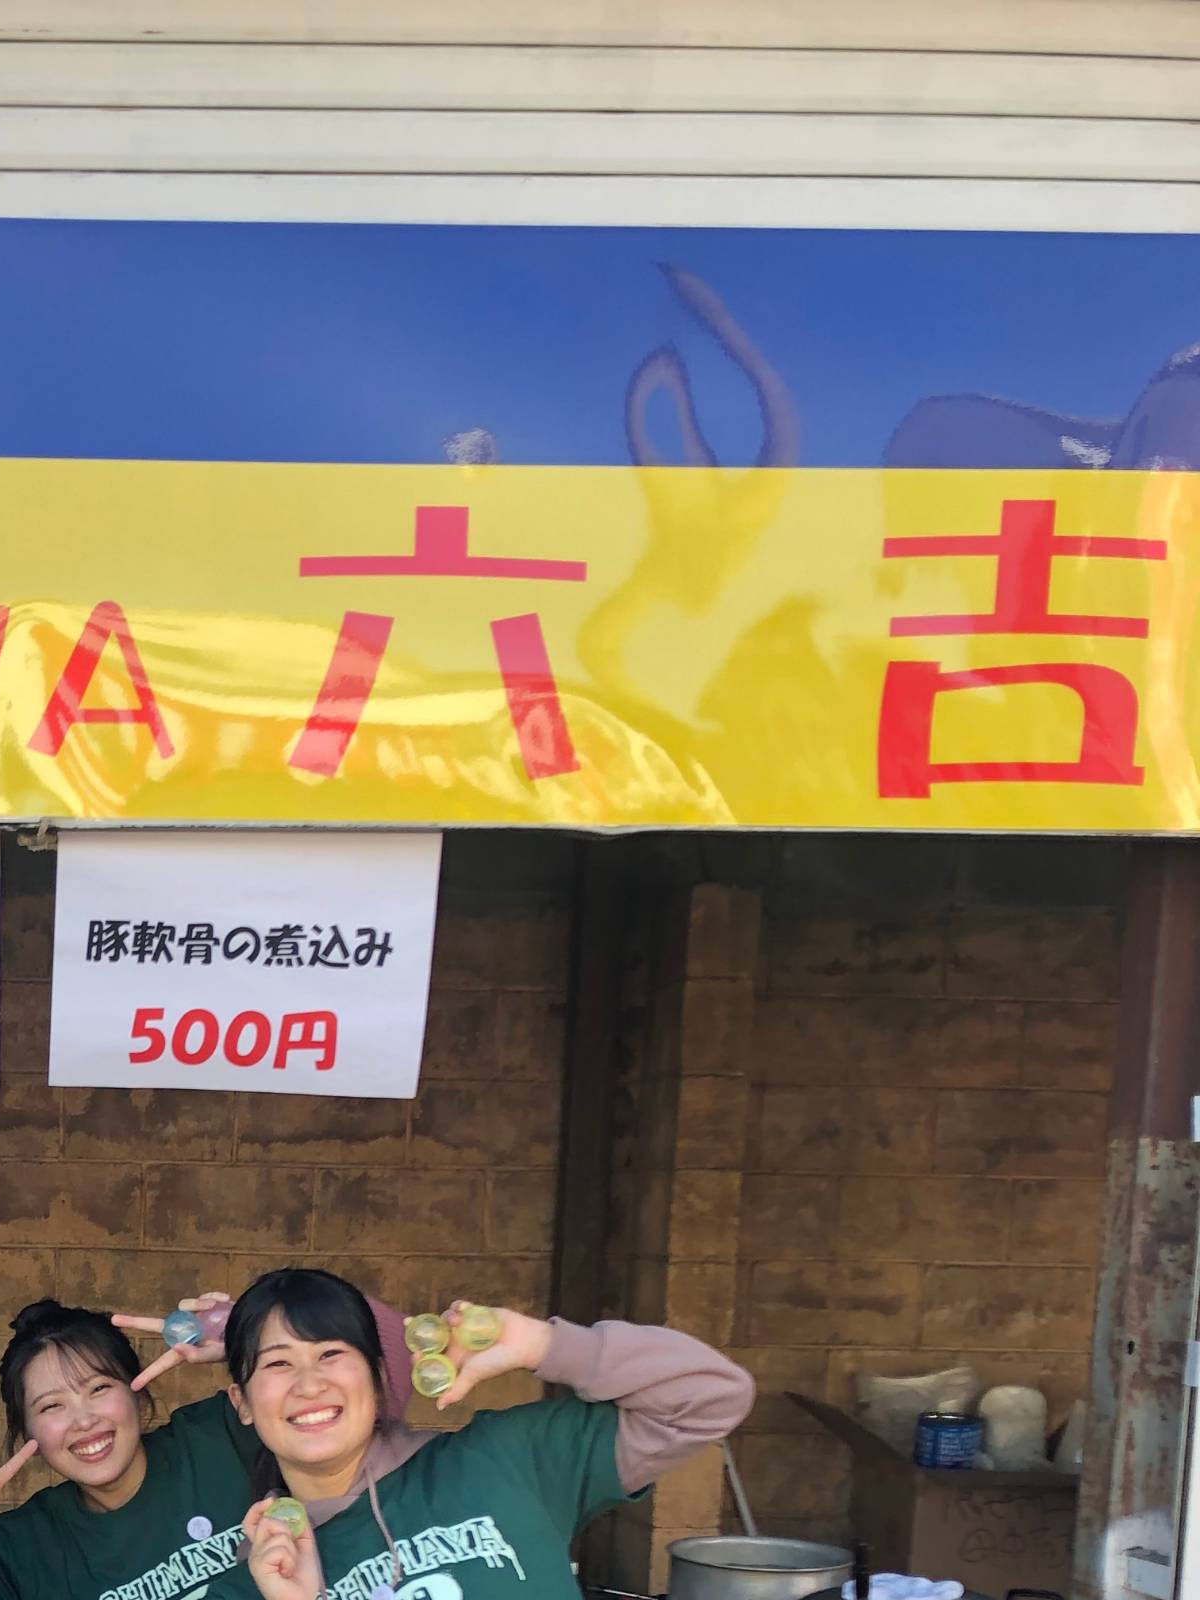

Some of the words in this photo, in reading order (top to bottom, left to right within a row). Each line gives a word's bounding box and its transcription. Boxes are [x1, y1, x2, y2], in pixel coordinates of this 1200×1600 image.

[286, 500, 1168, 799] 六吉
[86, 919, 394, 968] 豚軟骨の煮込み
[128, 1007, 338, 1071] 500円
